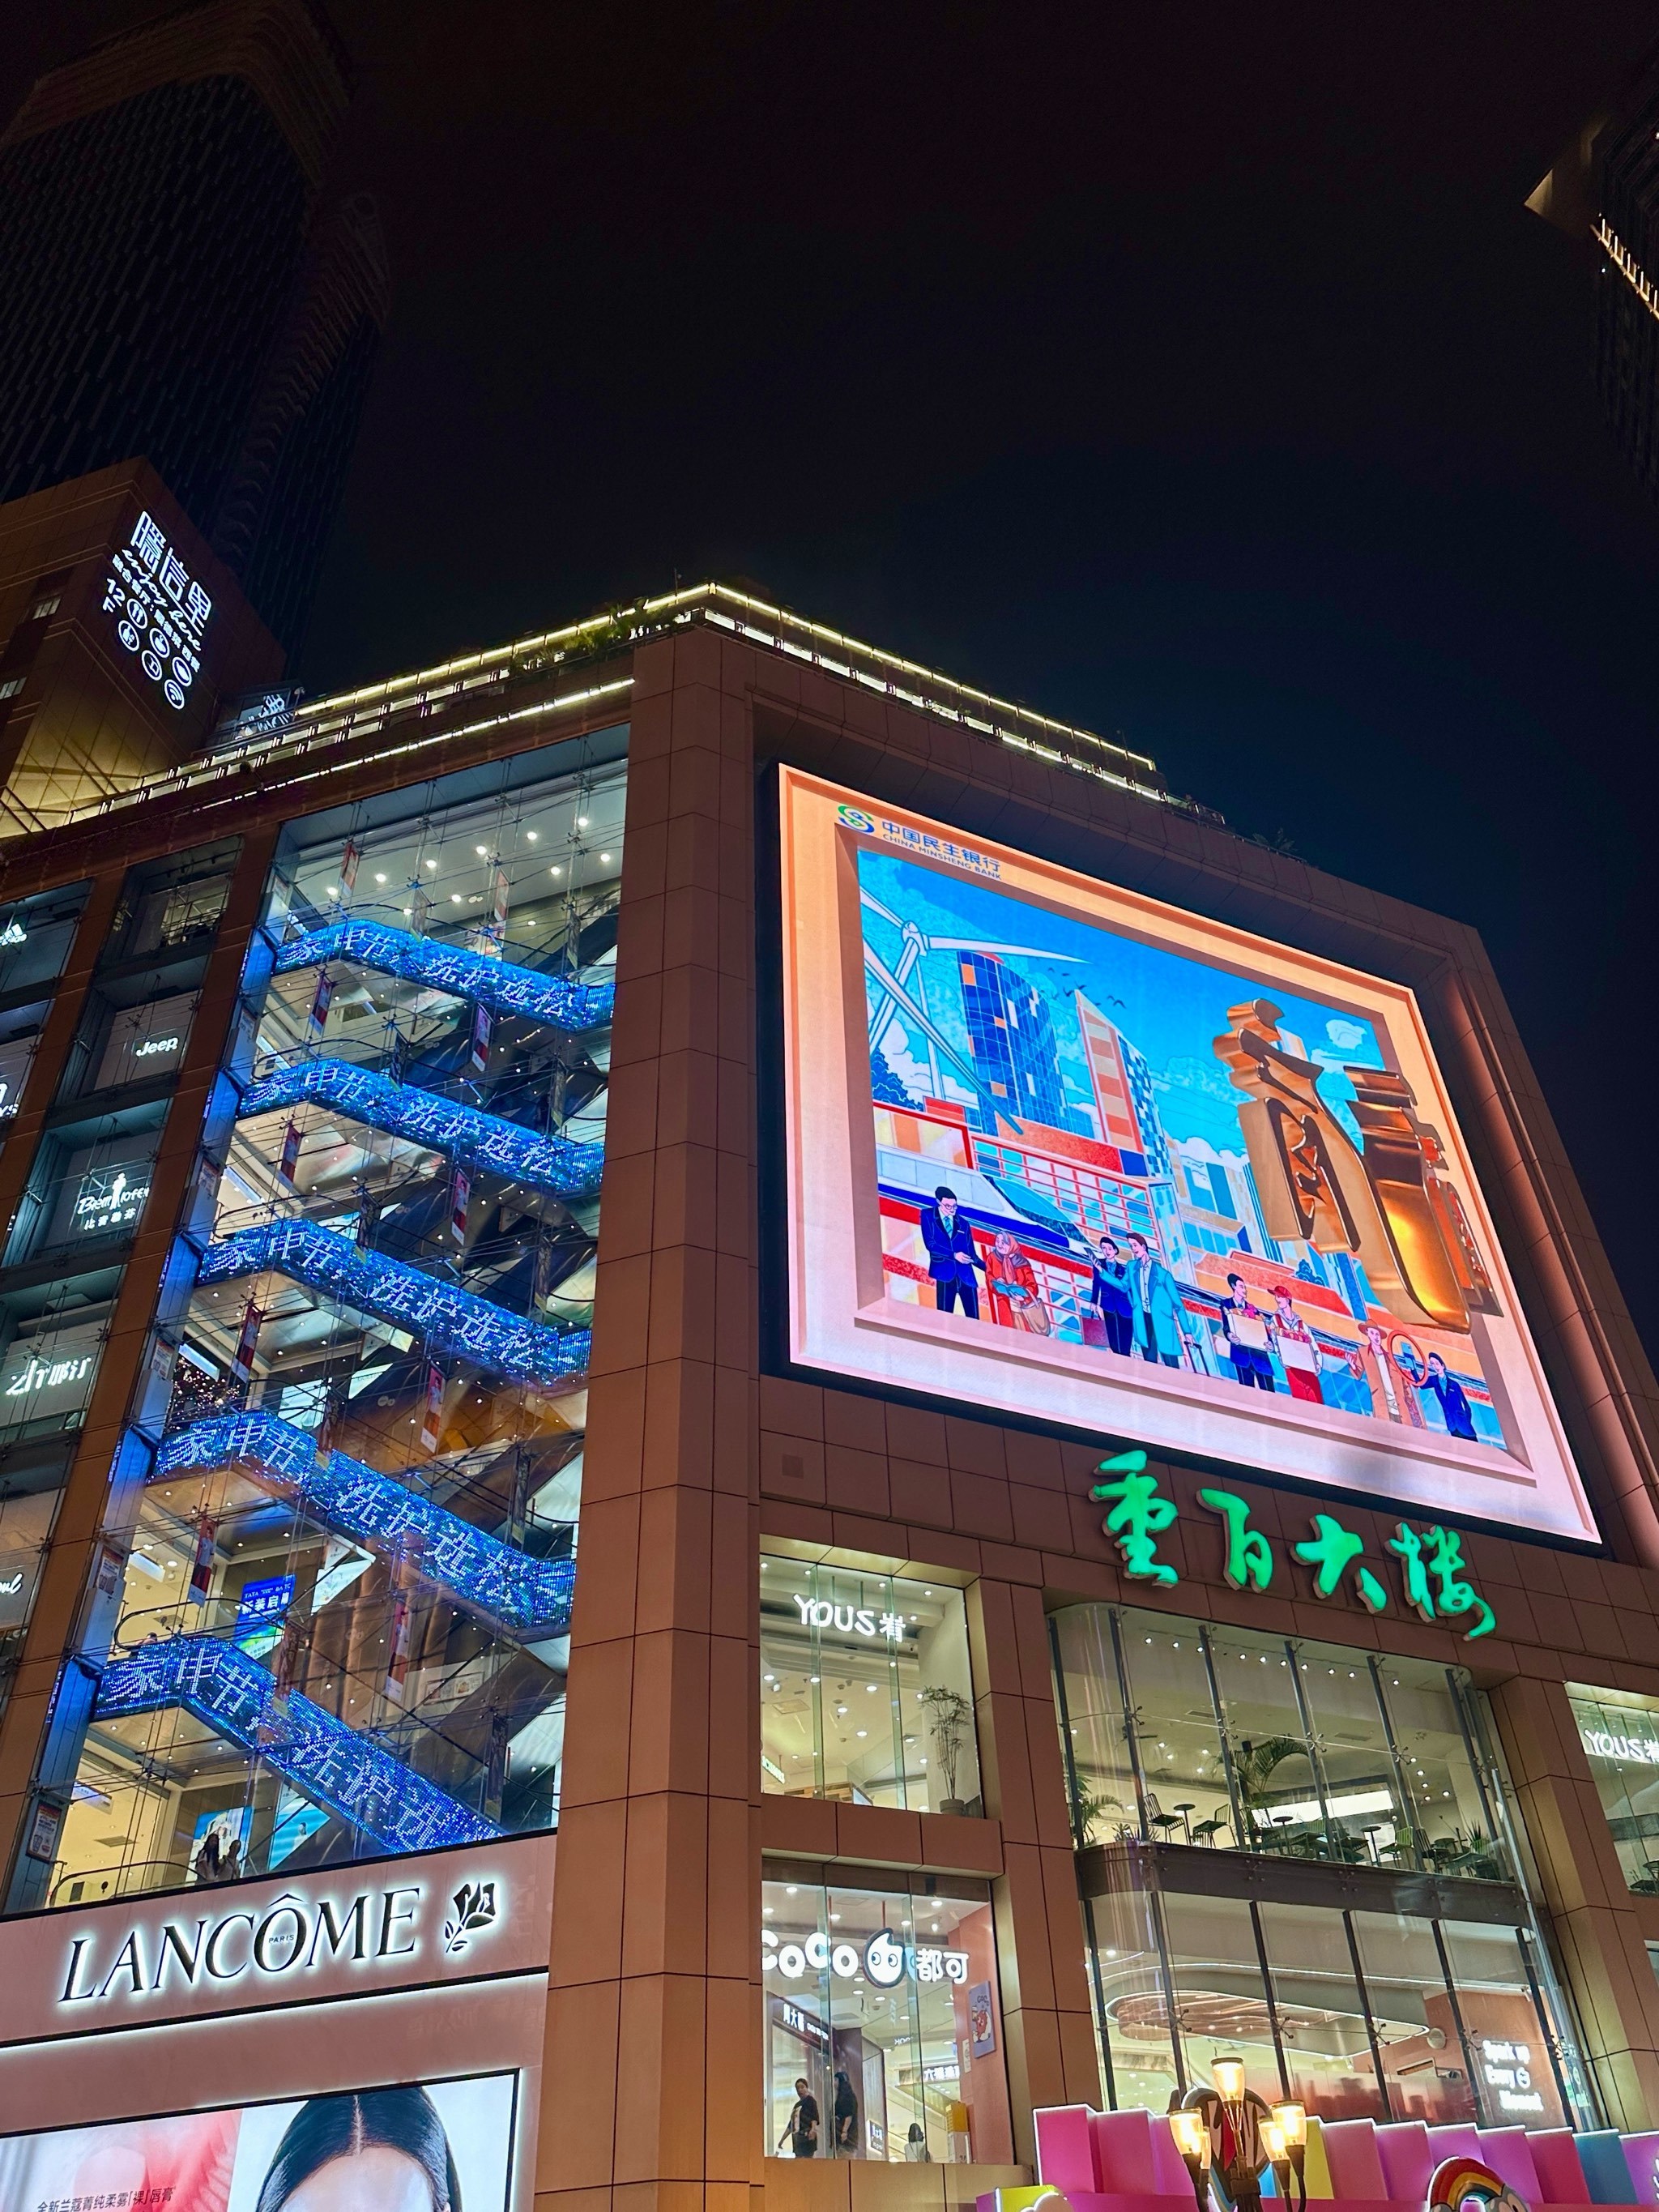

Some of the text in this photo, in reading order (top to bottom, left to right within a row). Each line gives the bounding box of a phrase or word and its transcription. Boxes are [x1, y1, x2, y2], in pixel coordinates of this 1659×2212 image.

[122, 549, 202, 651] enjoy here
[881, 820, 1001, 873] 中国民生银行
[882, 833, 1002, 881] CHINA MINSHENG BANK
[135, 1036, 178, 1057] Jeep
[1088, 1450, 1497, 1642] 重百大楼
[57, 1887, 420, 2004] LANCÔME
[268, 1934, 295, 1943] PARIS
[915, 1948, 970, 1984] 都可
